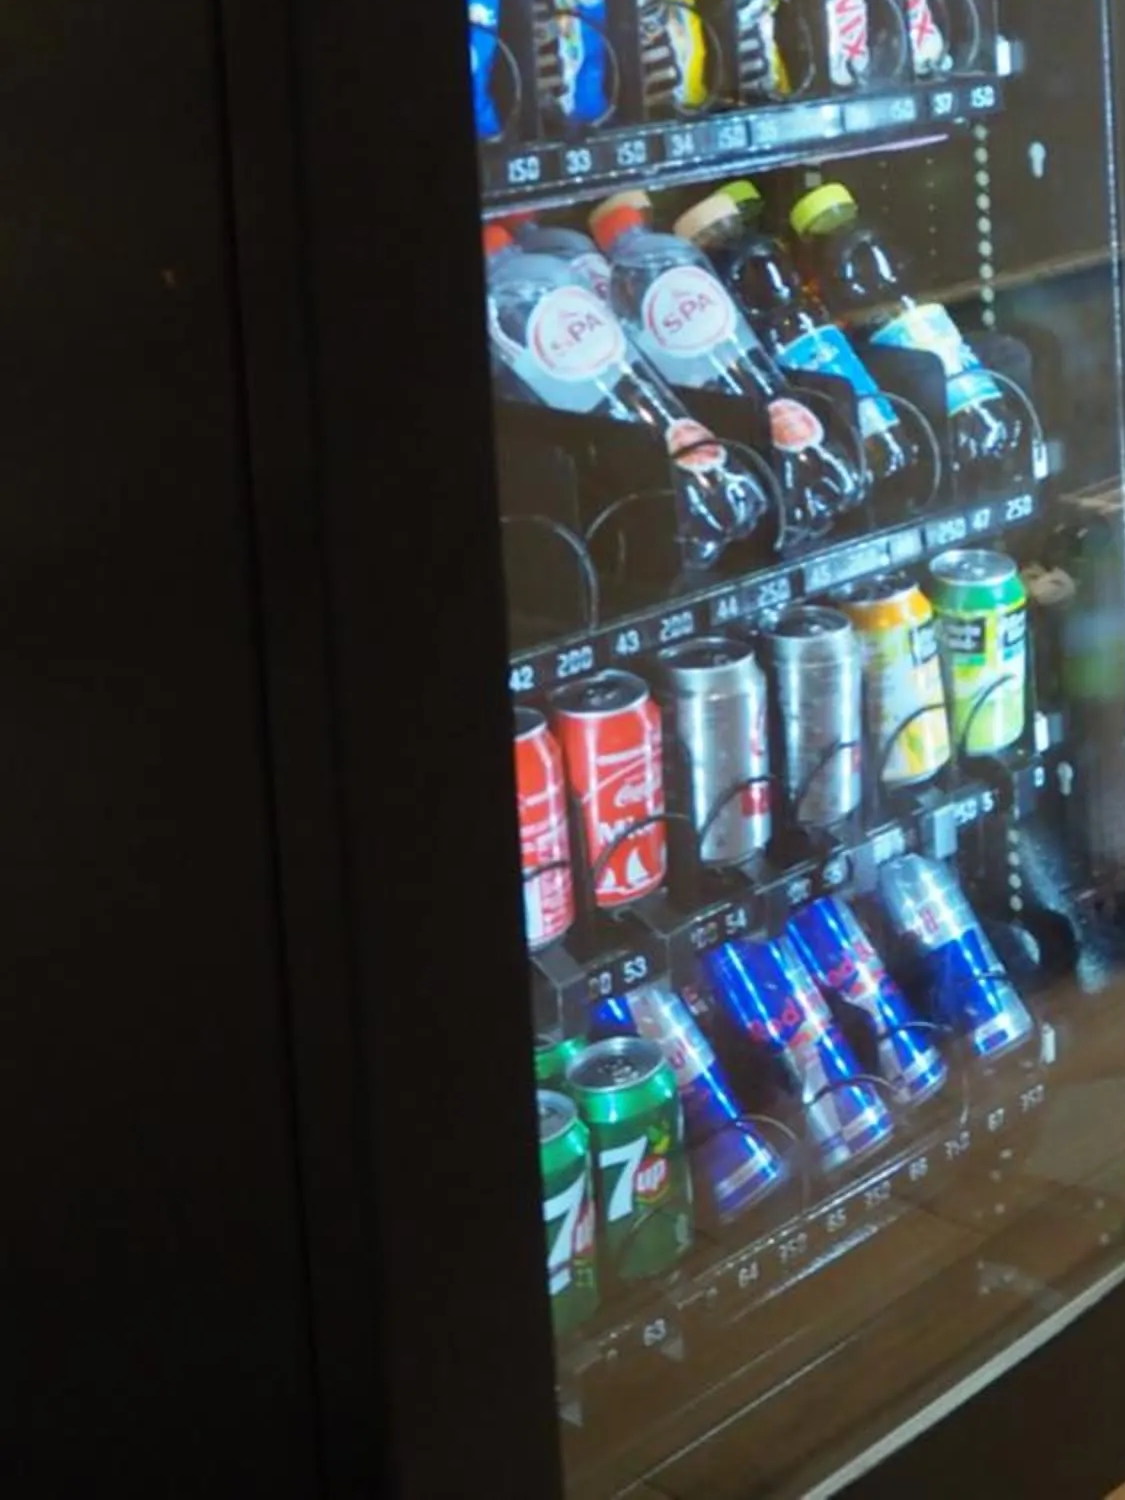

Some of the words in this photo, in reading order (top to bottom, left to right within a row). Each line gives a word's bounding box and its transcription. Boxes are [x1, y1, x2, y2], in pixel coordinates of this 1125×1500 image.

[508, 155, 541, 183] 150
[565, 148, 592, 175] 33
[616, 138, 648, 164] 150
[671, 134, 696, 157] 34
[661, 291, 720, 334] SPA
[508, 665, 535, 692] 42
[556, 645, 593, 678] 200
[614, 630, 640, 656] 43
[659, 611, 694, 642] 200
[716, 596, 739, 620] 44
[972, 508, 991, 532] 47
[1005, 493, 1033, 521] 250
[725, 907, 747, 935] 54
[622, 955, 648, 984] 53
[737, 1261, 760, 1287] 64
[987, 1108, 1006, 1133] 67
